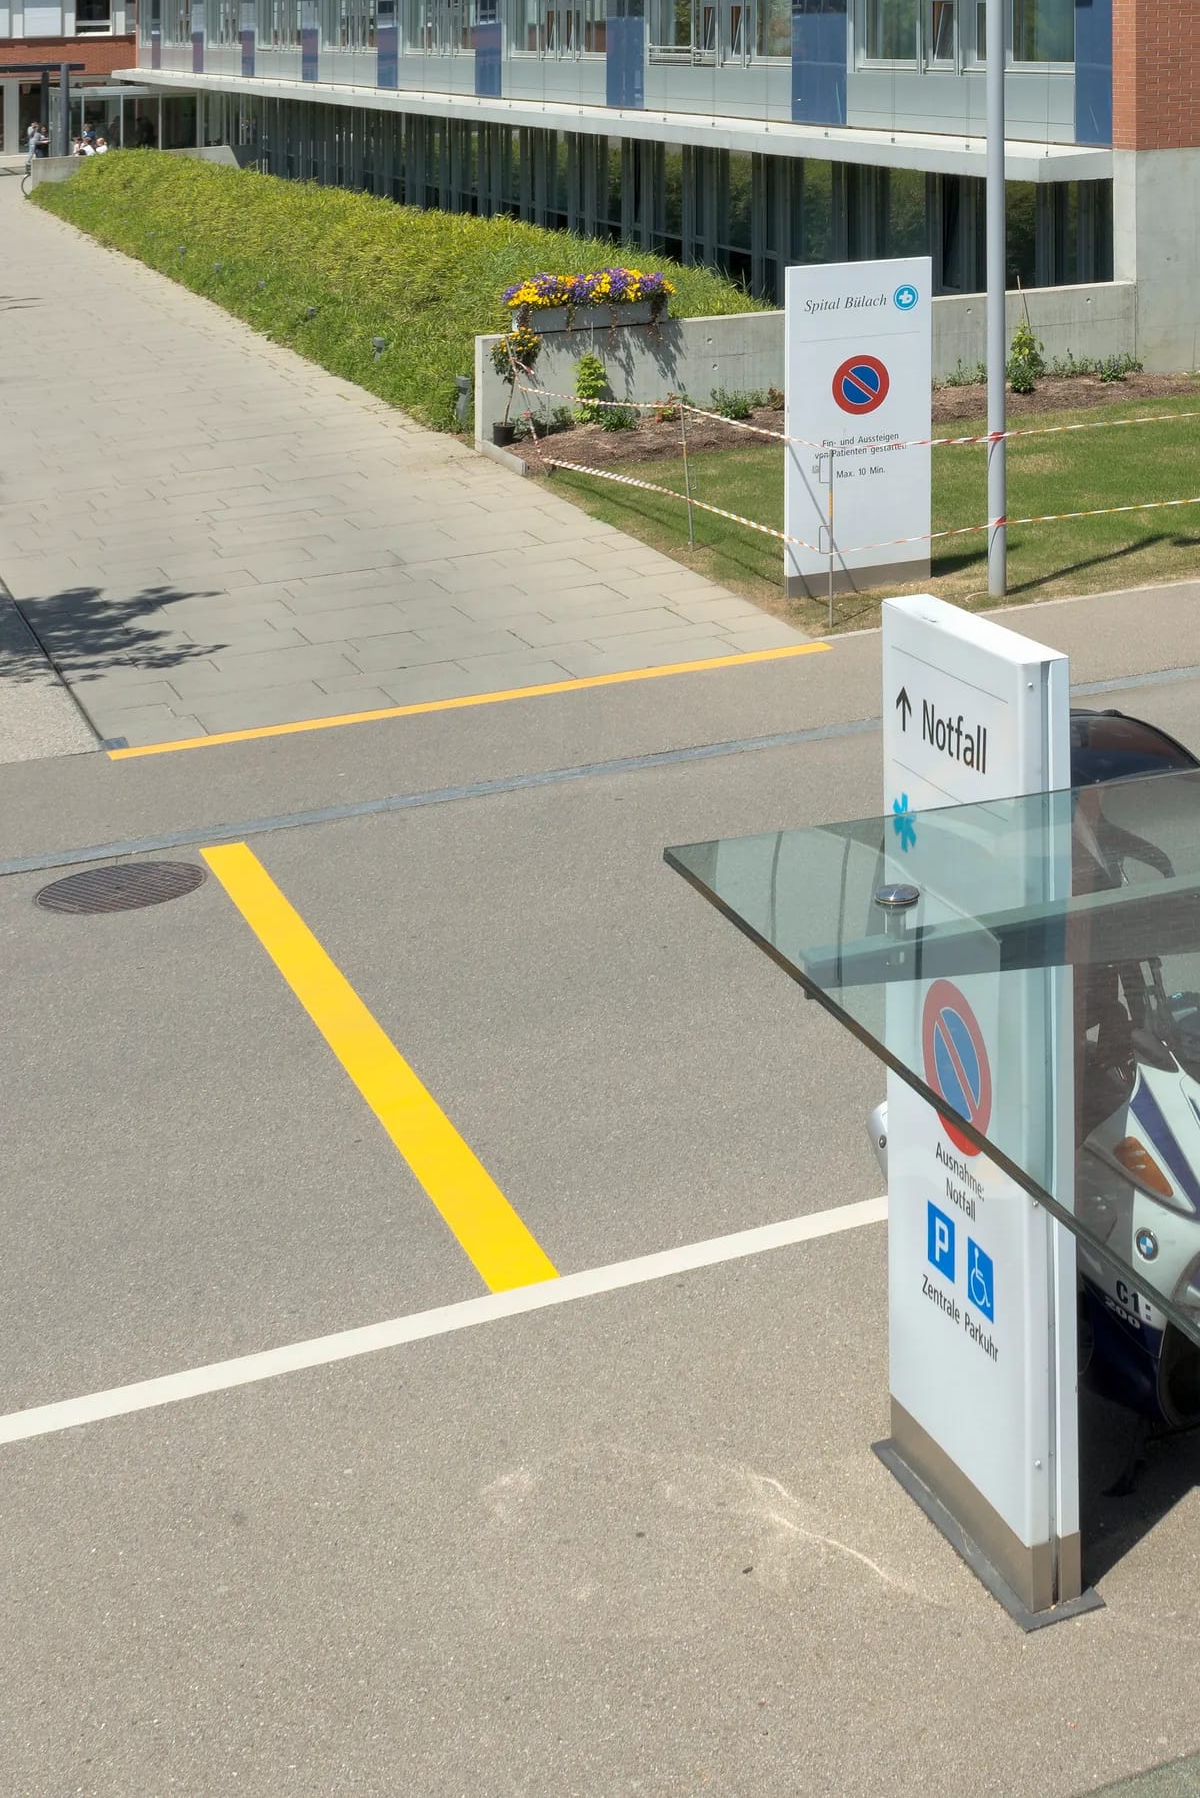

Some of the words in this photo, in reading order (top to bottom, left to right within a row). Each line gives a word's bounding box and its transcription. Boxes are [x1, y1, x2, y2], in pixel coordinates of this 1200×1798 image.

[804, 298, 840, 314] Spital
[844, 294, 887, 309] Bülach
[815, 451, 829, 459] von
[832, 447, 867, 457] Patienten
[840, 437, 854, 446] und
[858, 433, 899, 444] Aussteigen
[836, 470, 855, 478] Max.
[859, 467, 866, 475] 10
[870, 466, 886, 474] Min.
[923, 698, 986, 775] Notfall
[935, 1141, 985, 1202] Ausnahme:
[946, 1177, 976, 1223] Notfall
[935, 1216, 949, 1263] P
[922, 1274, 961, 1325] Zentrale
[964, 1312, 998, 1362] Parkuhr
